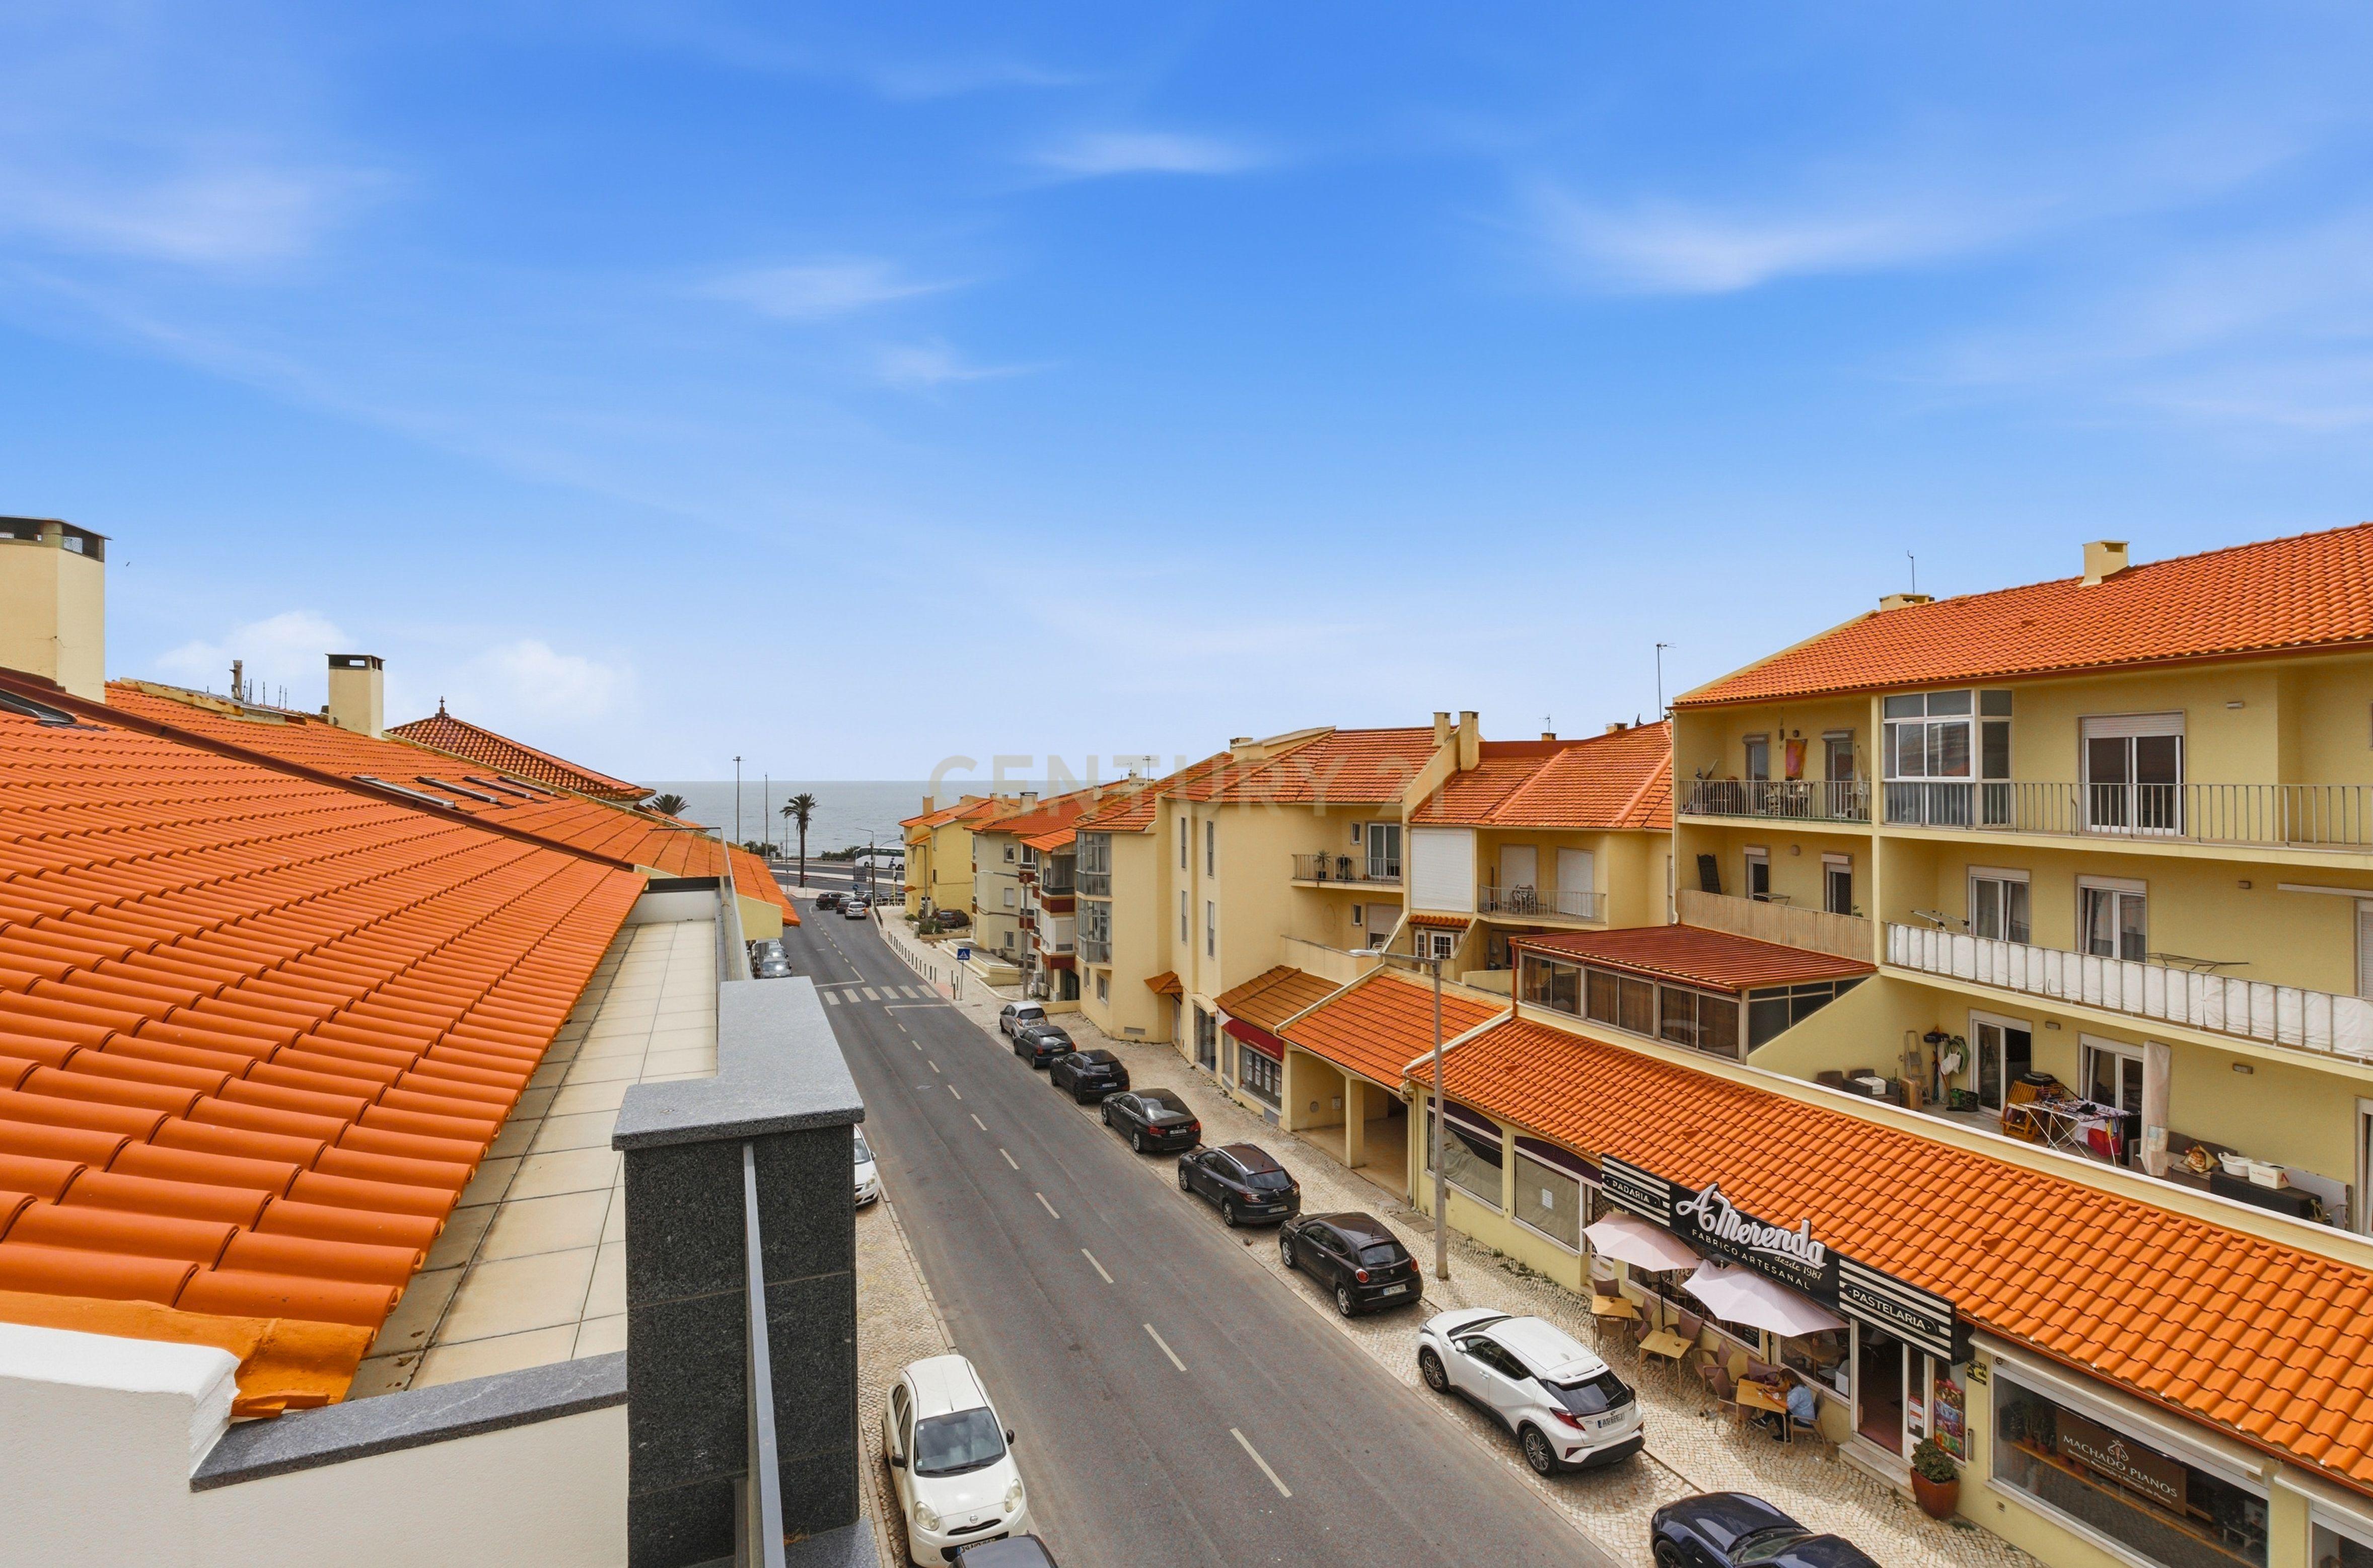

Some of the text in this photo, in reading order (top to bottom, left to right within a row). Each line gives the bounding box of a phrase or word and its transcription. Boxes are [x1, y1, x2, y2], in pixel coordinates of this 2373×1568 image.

[1613, 1180, 1649, 1203] PADARIA
[1676, 1183, 1828, 1267] A Merenda
[1692, 1228, 1811, 1291] FABRICO ARTESANAL
[1774, 1255, 1801, 1271] desde
[1853, 1289, 1926, 1330] PASTELARIA
[2063, 1435, 2126, 1471] MACHADO
[2130, 1467, 2178, 1498] PIANOS
